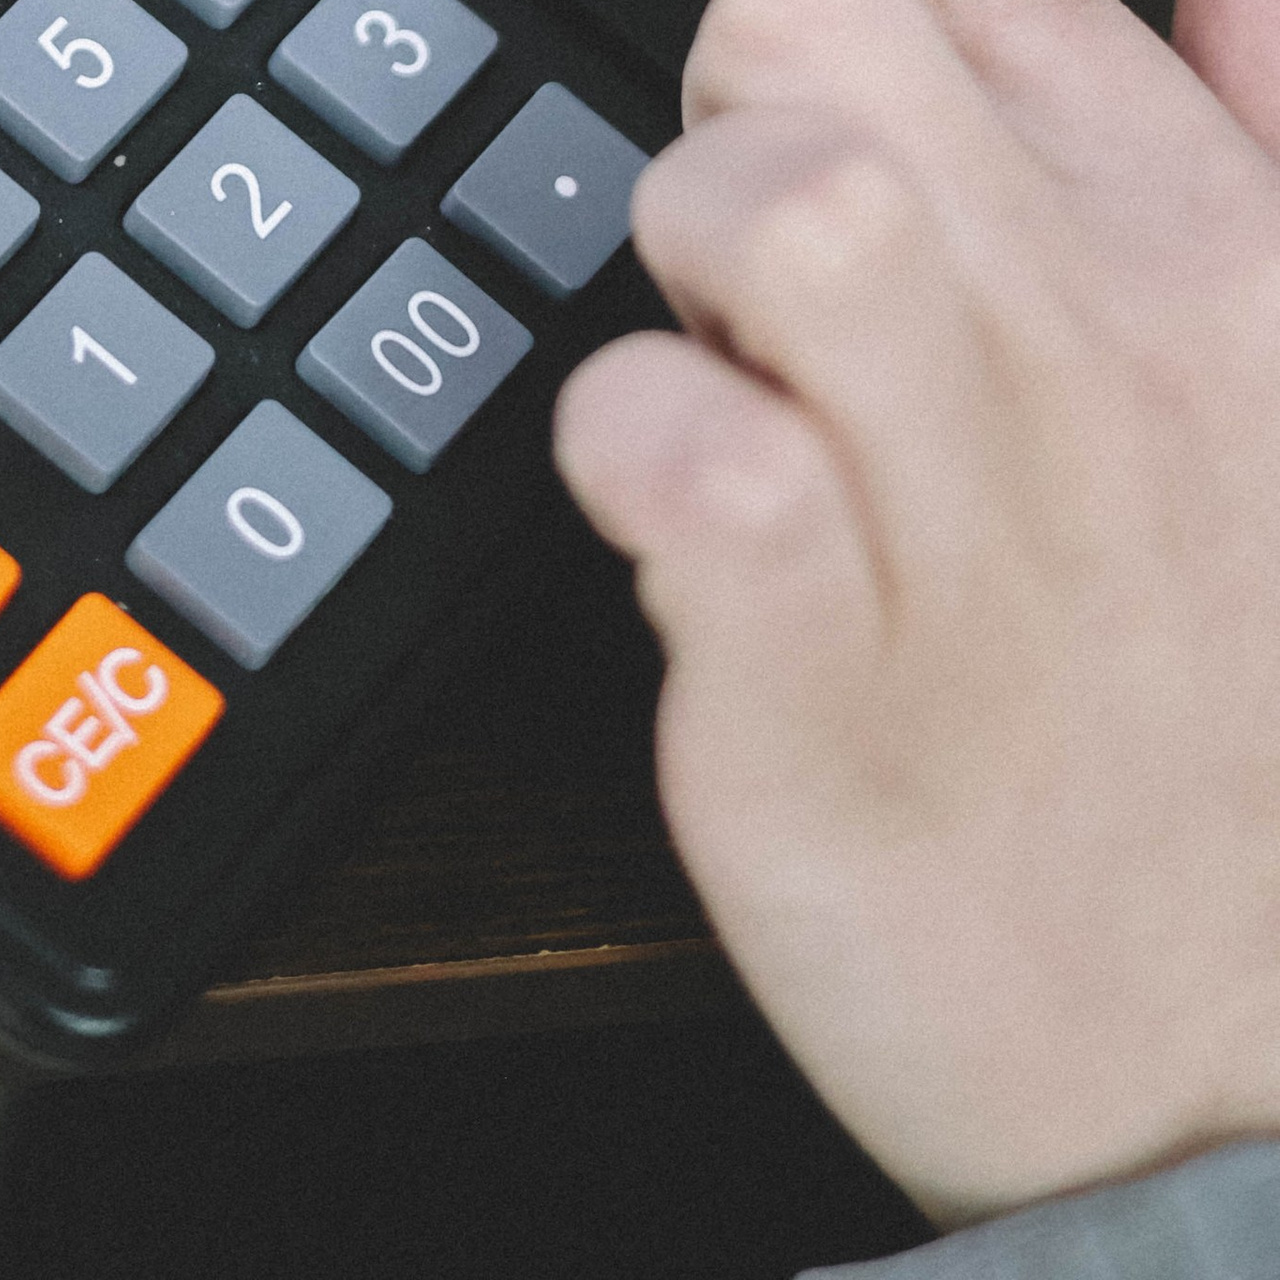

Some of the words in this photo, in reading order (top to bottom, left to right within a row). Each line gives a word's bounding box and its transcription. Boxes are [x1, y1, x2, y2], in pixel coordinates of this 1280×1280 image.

[36, 15, 115, 90] 5
[353, 9, 429, 76] 3
[209, 162, 294, 240] 2
[71, 324, 139, 386] 1
[369, 289, 481, 397] 00
[225, 486, 304, 559] 0
[13, 646, 171, 808] CE/C
